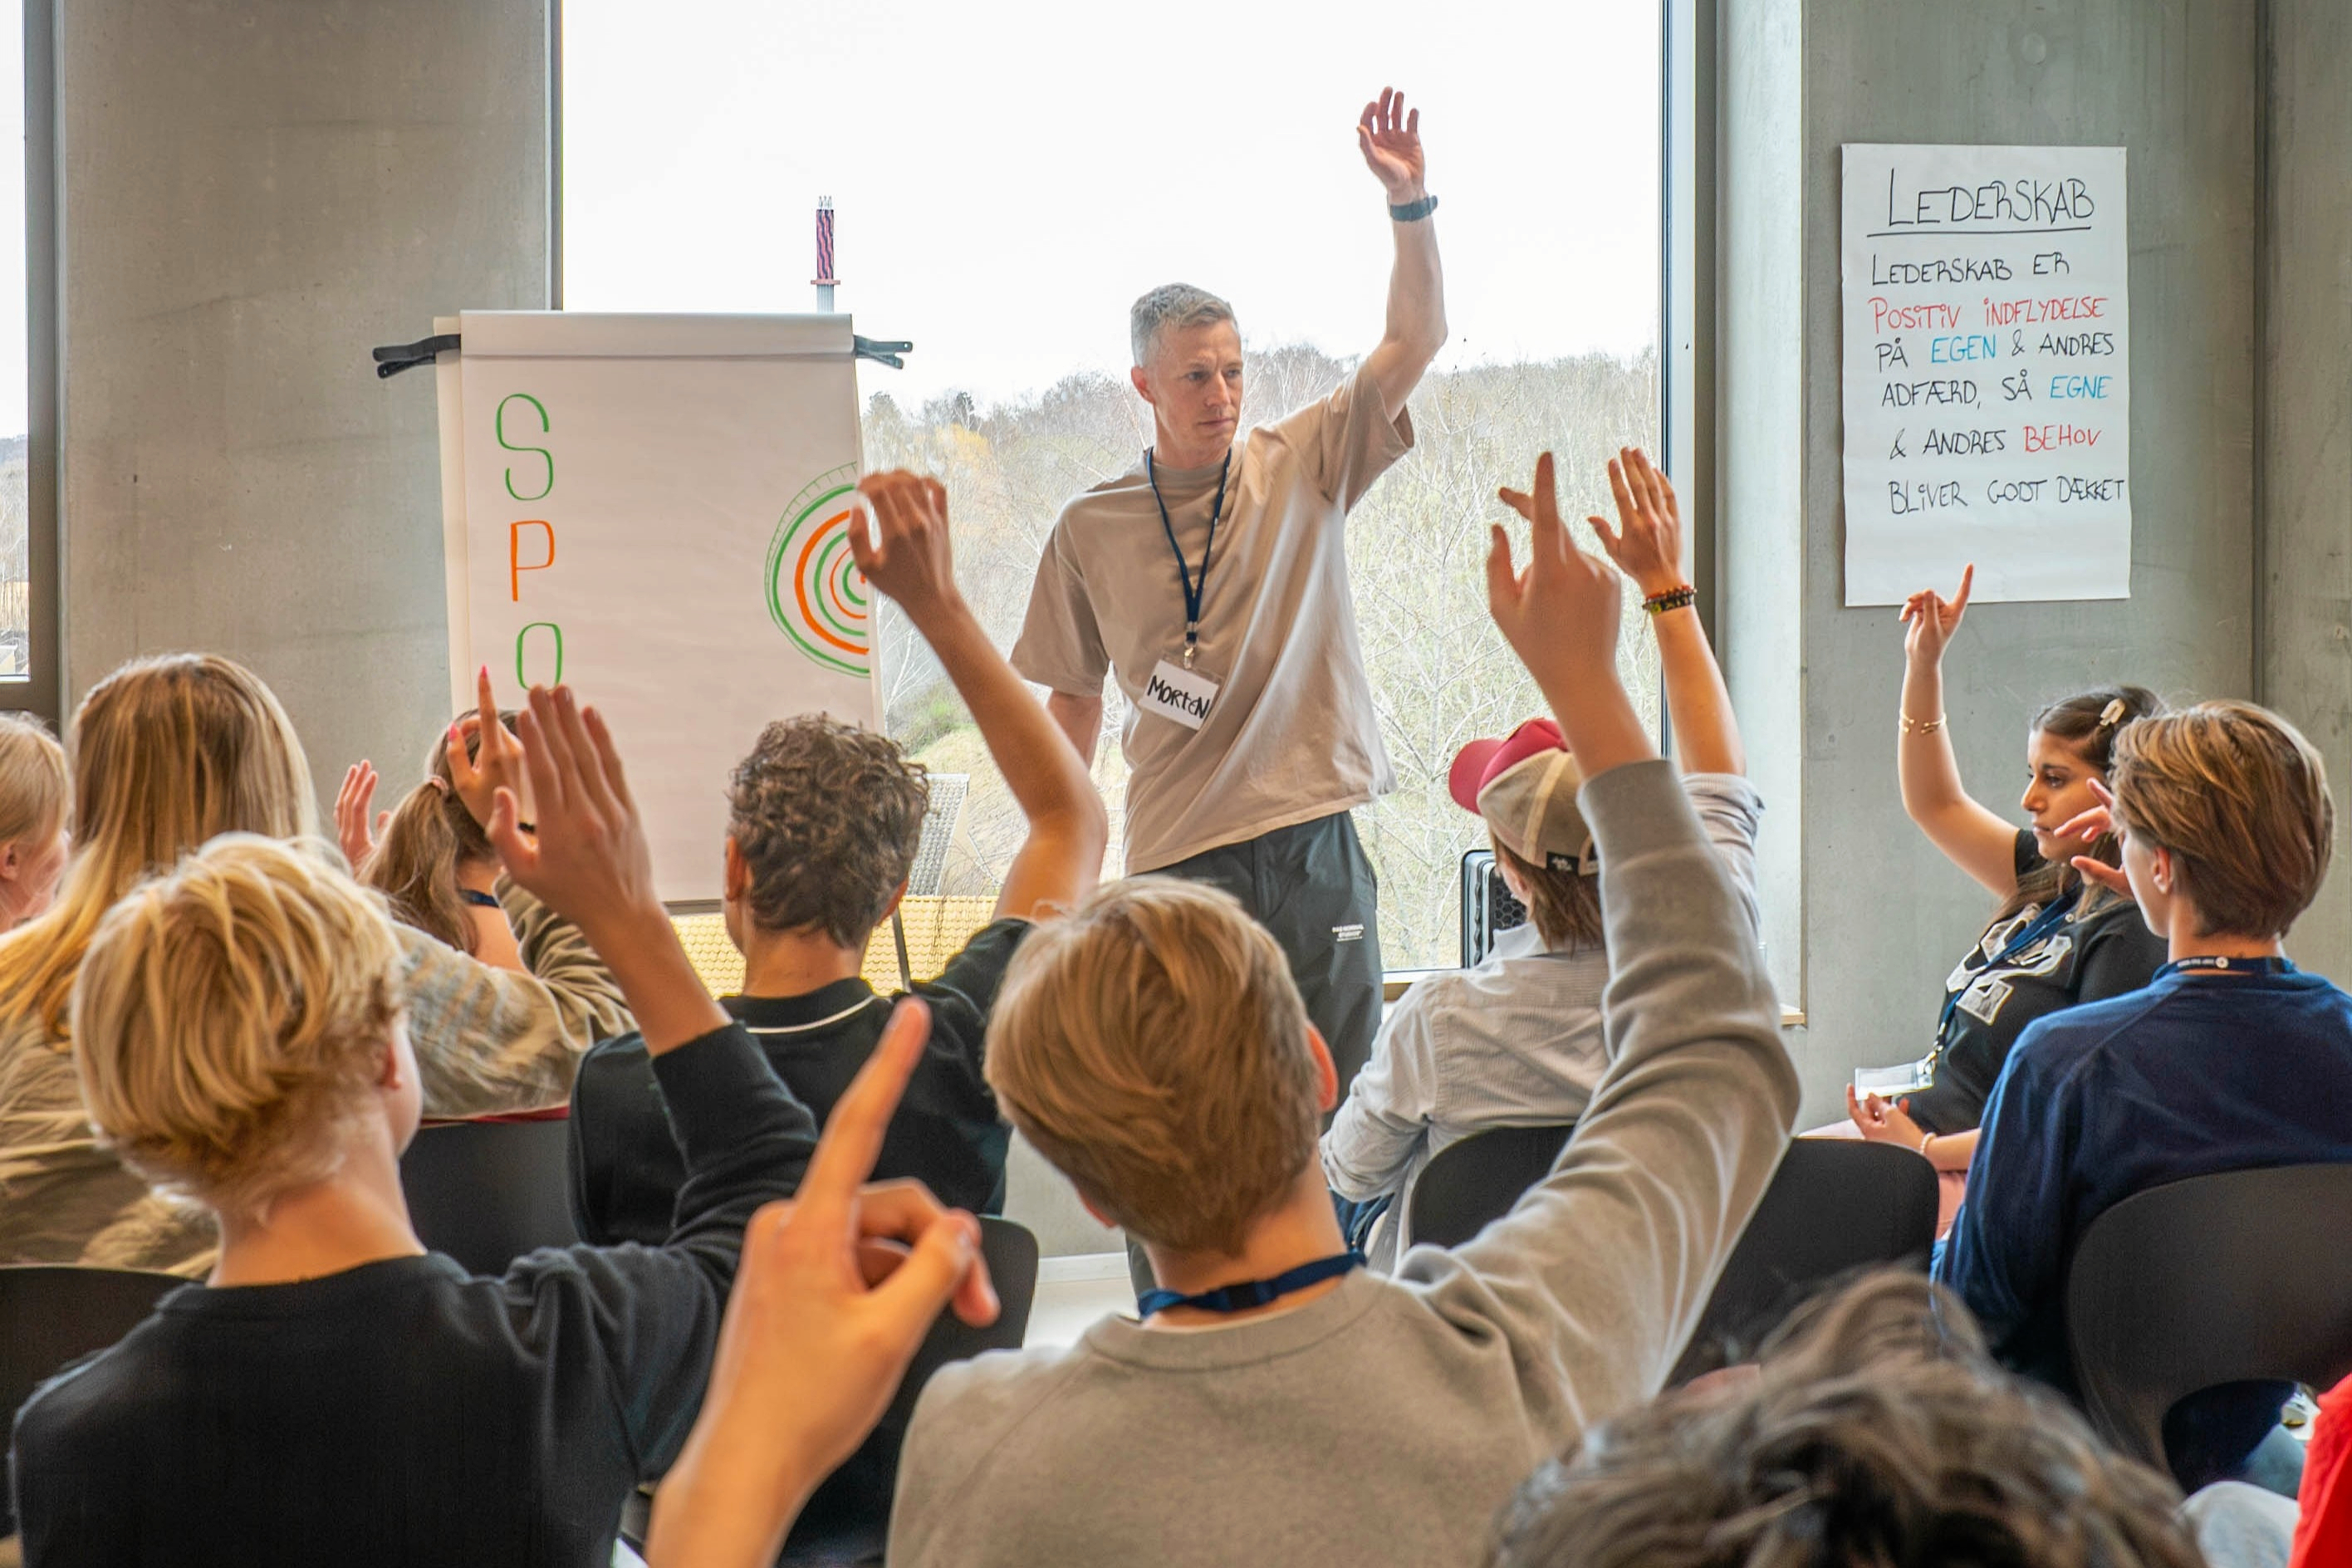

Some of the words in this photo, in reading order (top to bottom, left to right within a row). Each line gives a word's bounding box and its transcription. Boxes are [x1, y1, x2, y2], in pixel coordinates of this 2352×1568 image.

[1889, 167, 2095, 227] LEDERSKAB
[1872, 253, 2012, 286] LEDERSKAB
[2033, 252, 2070, 275] ER
[1874, 337, 1909, 373] PÅ
[1931, 334, 1997, 364] EGEN
[2011, 329, 2026, 357] &
[2038, 332, 2114, 357] ANDRES
[1881, 380, 1982, 410] ADFÆRD,
[2002, 369, 2032, 401] SÅ
[2050, 375, 2114, 399] EGNE
[496, 393, 554, 502] S
[1889, 428, 1907, 460] &
[1922, 428, 2007, 455] ANDRES
[2022, 424, 2102, 453] BEHOV
[1987, 479, 2048, 504] GODT
[2056, 475, 2125, 503] DÆKKET
[510, 520, 555, 602] P
